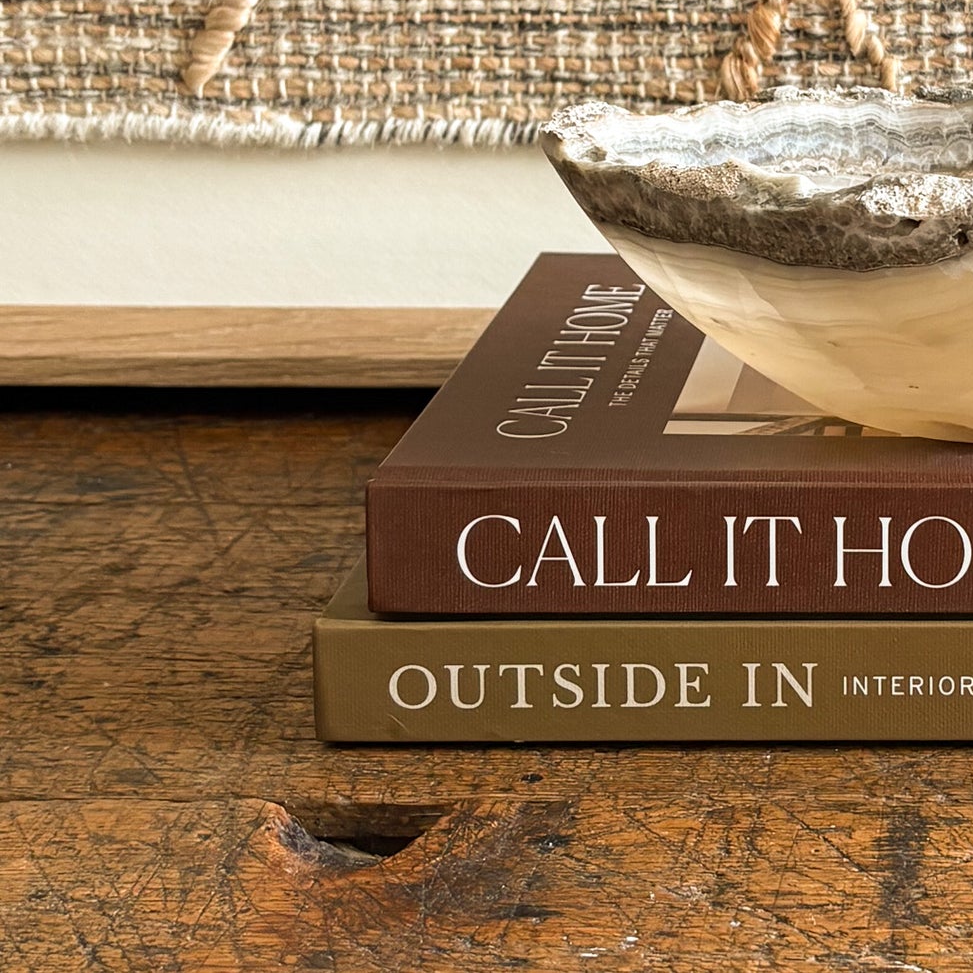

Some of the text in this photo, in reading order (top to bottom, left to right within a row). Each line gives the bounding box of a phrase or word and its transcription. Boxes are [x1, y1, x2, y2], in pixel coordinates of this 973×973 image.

[496, 283, 646, 439] CALL IT HOME
[608, 308, 674, 407] THE DETAILS THAT MATTER
[456, 514, 693, 588] CALL
[723, 516, 803, 587] IT
[388, 662, 818, 710] OUTSIDE IN
